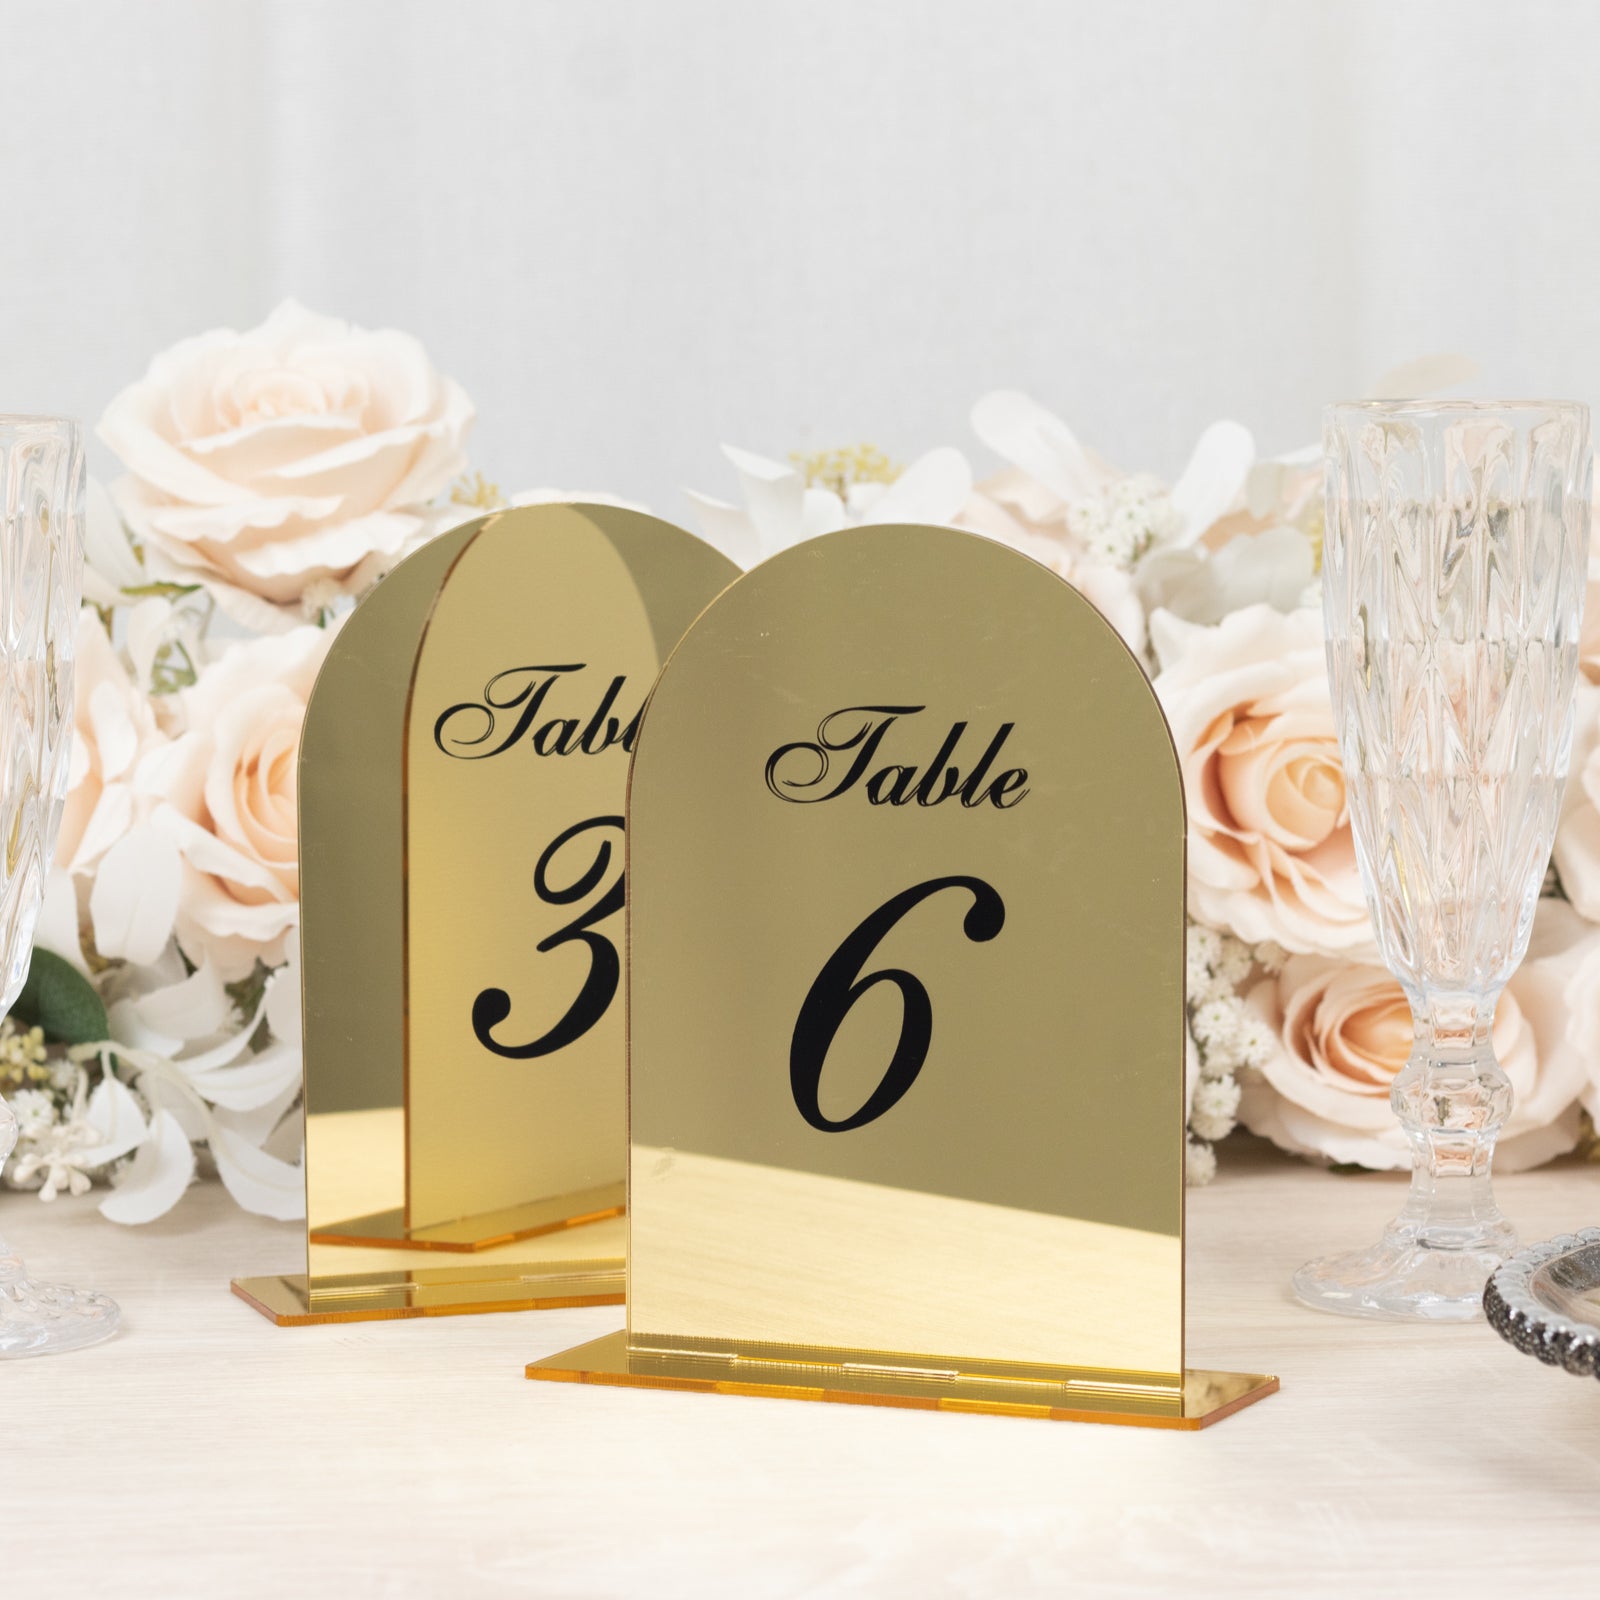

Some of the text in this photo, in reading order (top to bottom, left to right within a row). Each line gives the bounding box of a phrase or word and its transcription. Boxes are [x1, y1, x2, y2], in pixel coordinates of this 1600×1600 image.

[434, 663, 648, 760] Tabl
[765, 705, 1031, 810] Table
[471, 815, 626, 1060] 3
[789, 875, 1006, 1133] 6
